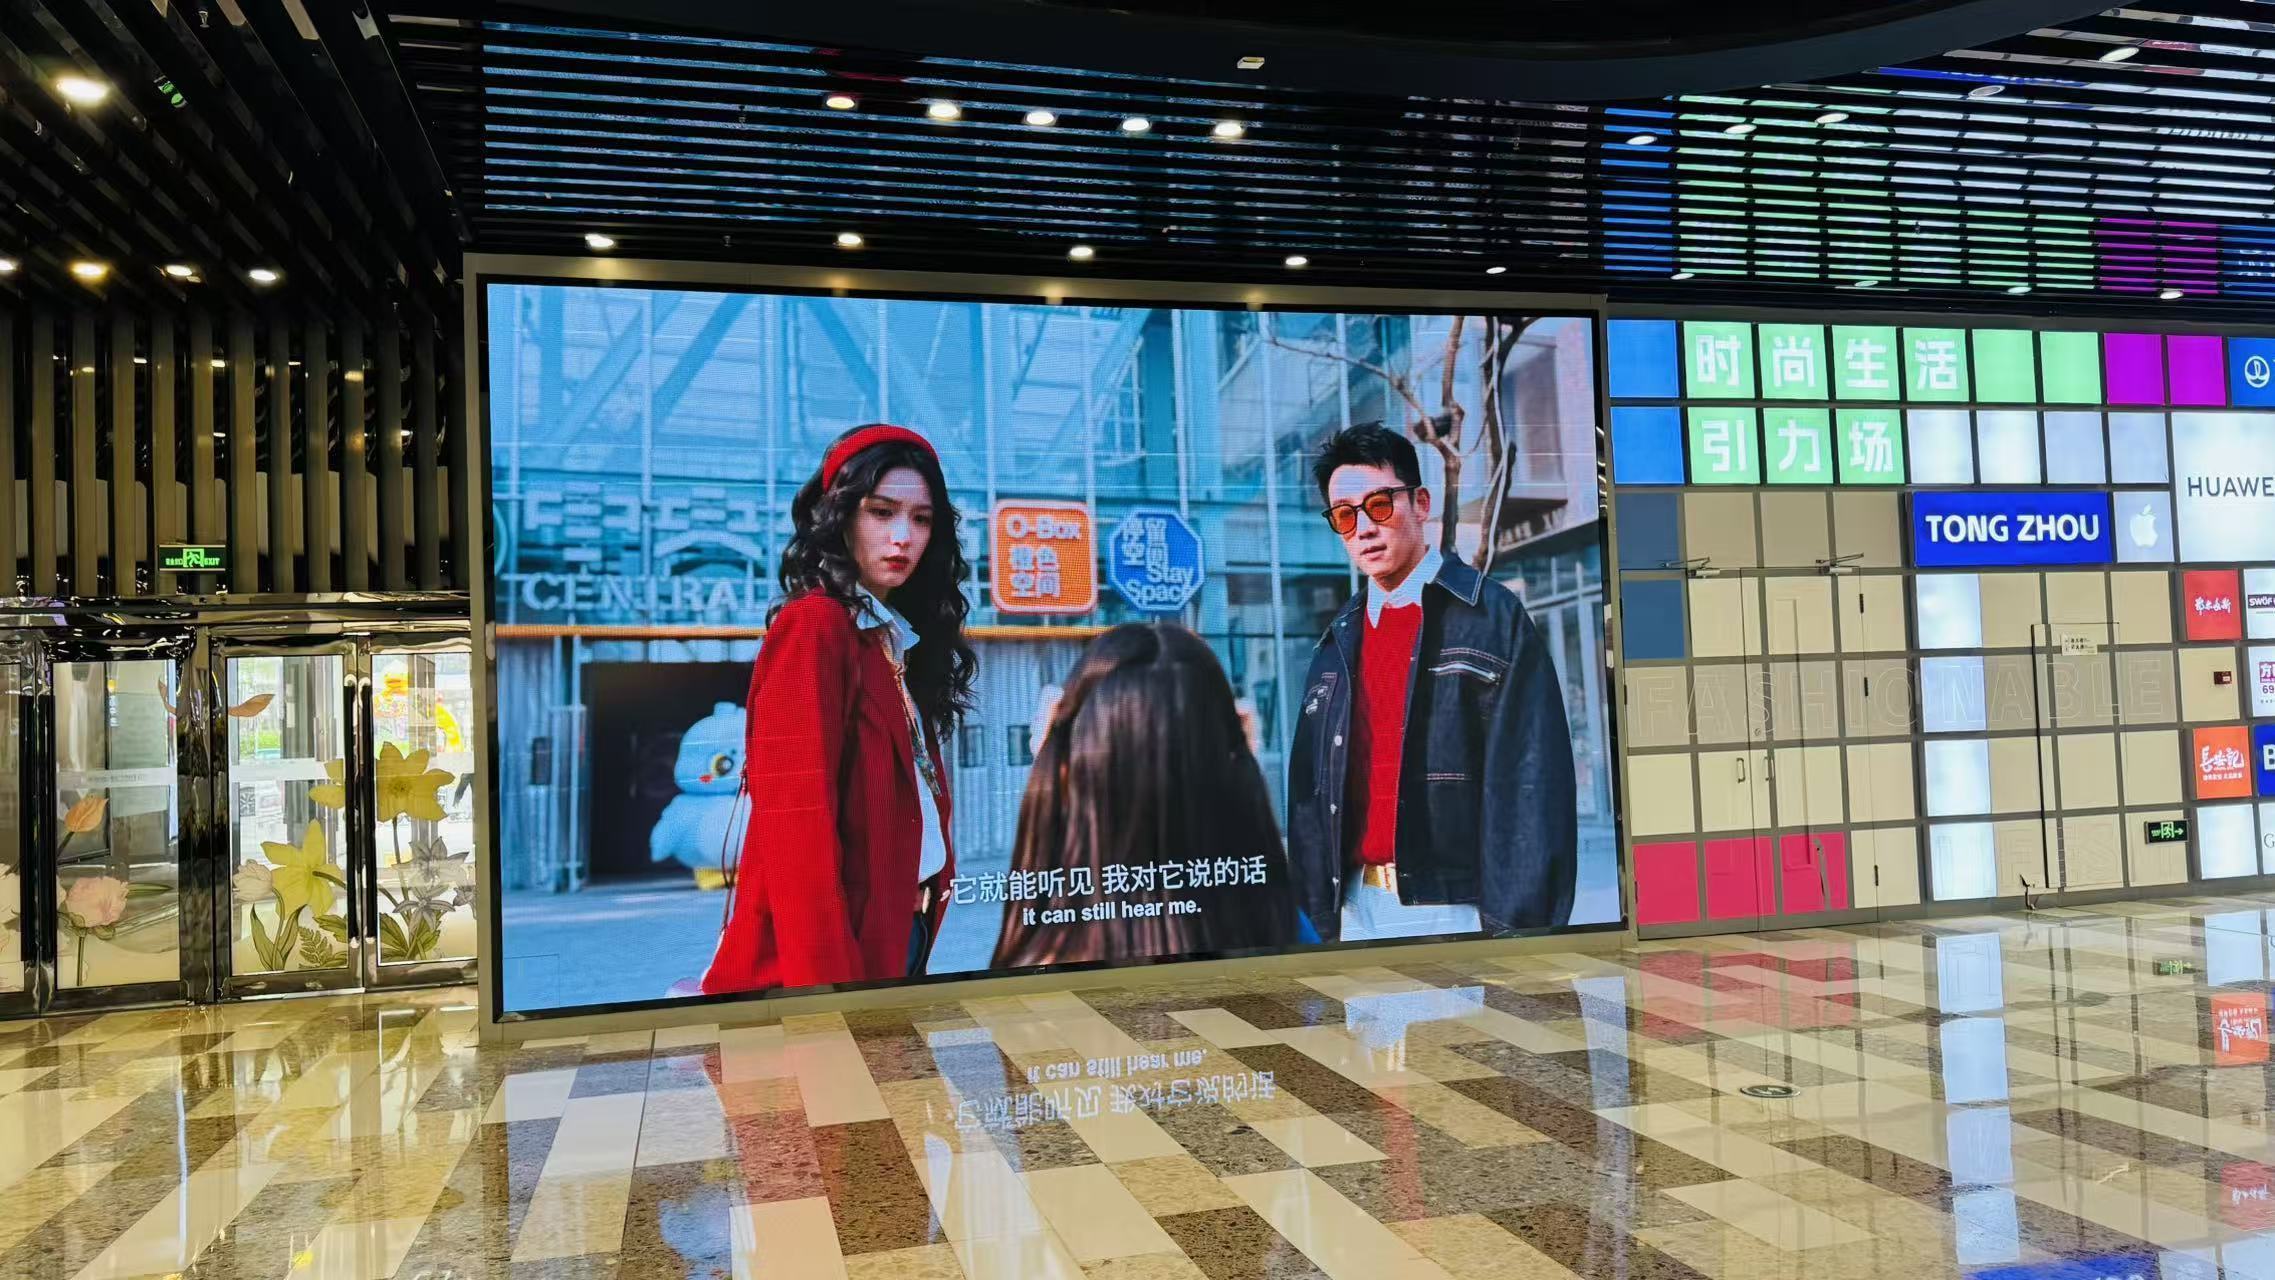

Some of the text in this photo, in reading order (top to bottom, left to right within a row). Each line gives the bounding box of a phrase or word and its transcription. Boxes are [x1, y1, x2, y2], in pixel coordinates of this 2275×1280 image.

[1696, 334, 1958, 391] 时尚生活
[1703, 419, 1893, 473] 引力场
[1925, 511, 2101, 544] TONG ZHOU
[204, 557, 220, 566] EXIT
[1147, 562, 1194, 586] Stay
[1011, 571, 1061, 598] 空间
[1632, 660, 2165, 740] FASHIONABLE
[950, 854, 1269, 906] 它就能听见 我对它说的话
[1022, 899, 1203, 926] it can still hear me.
